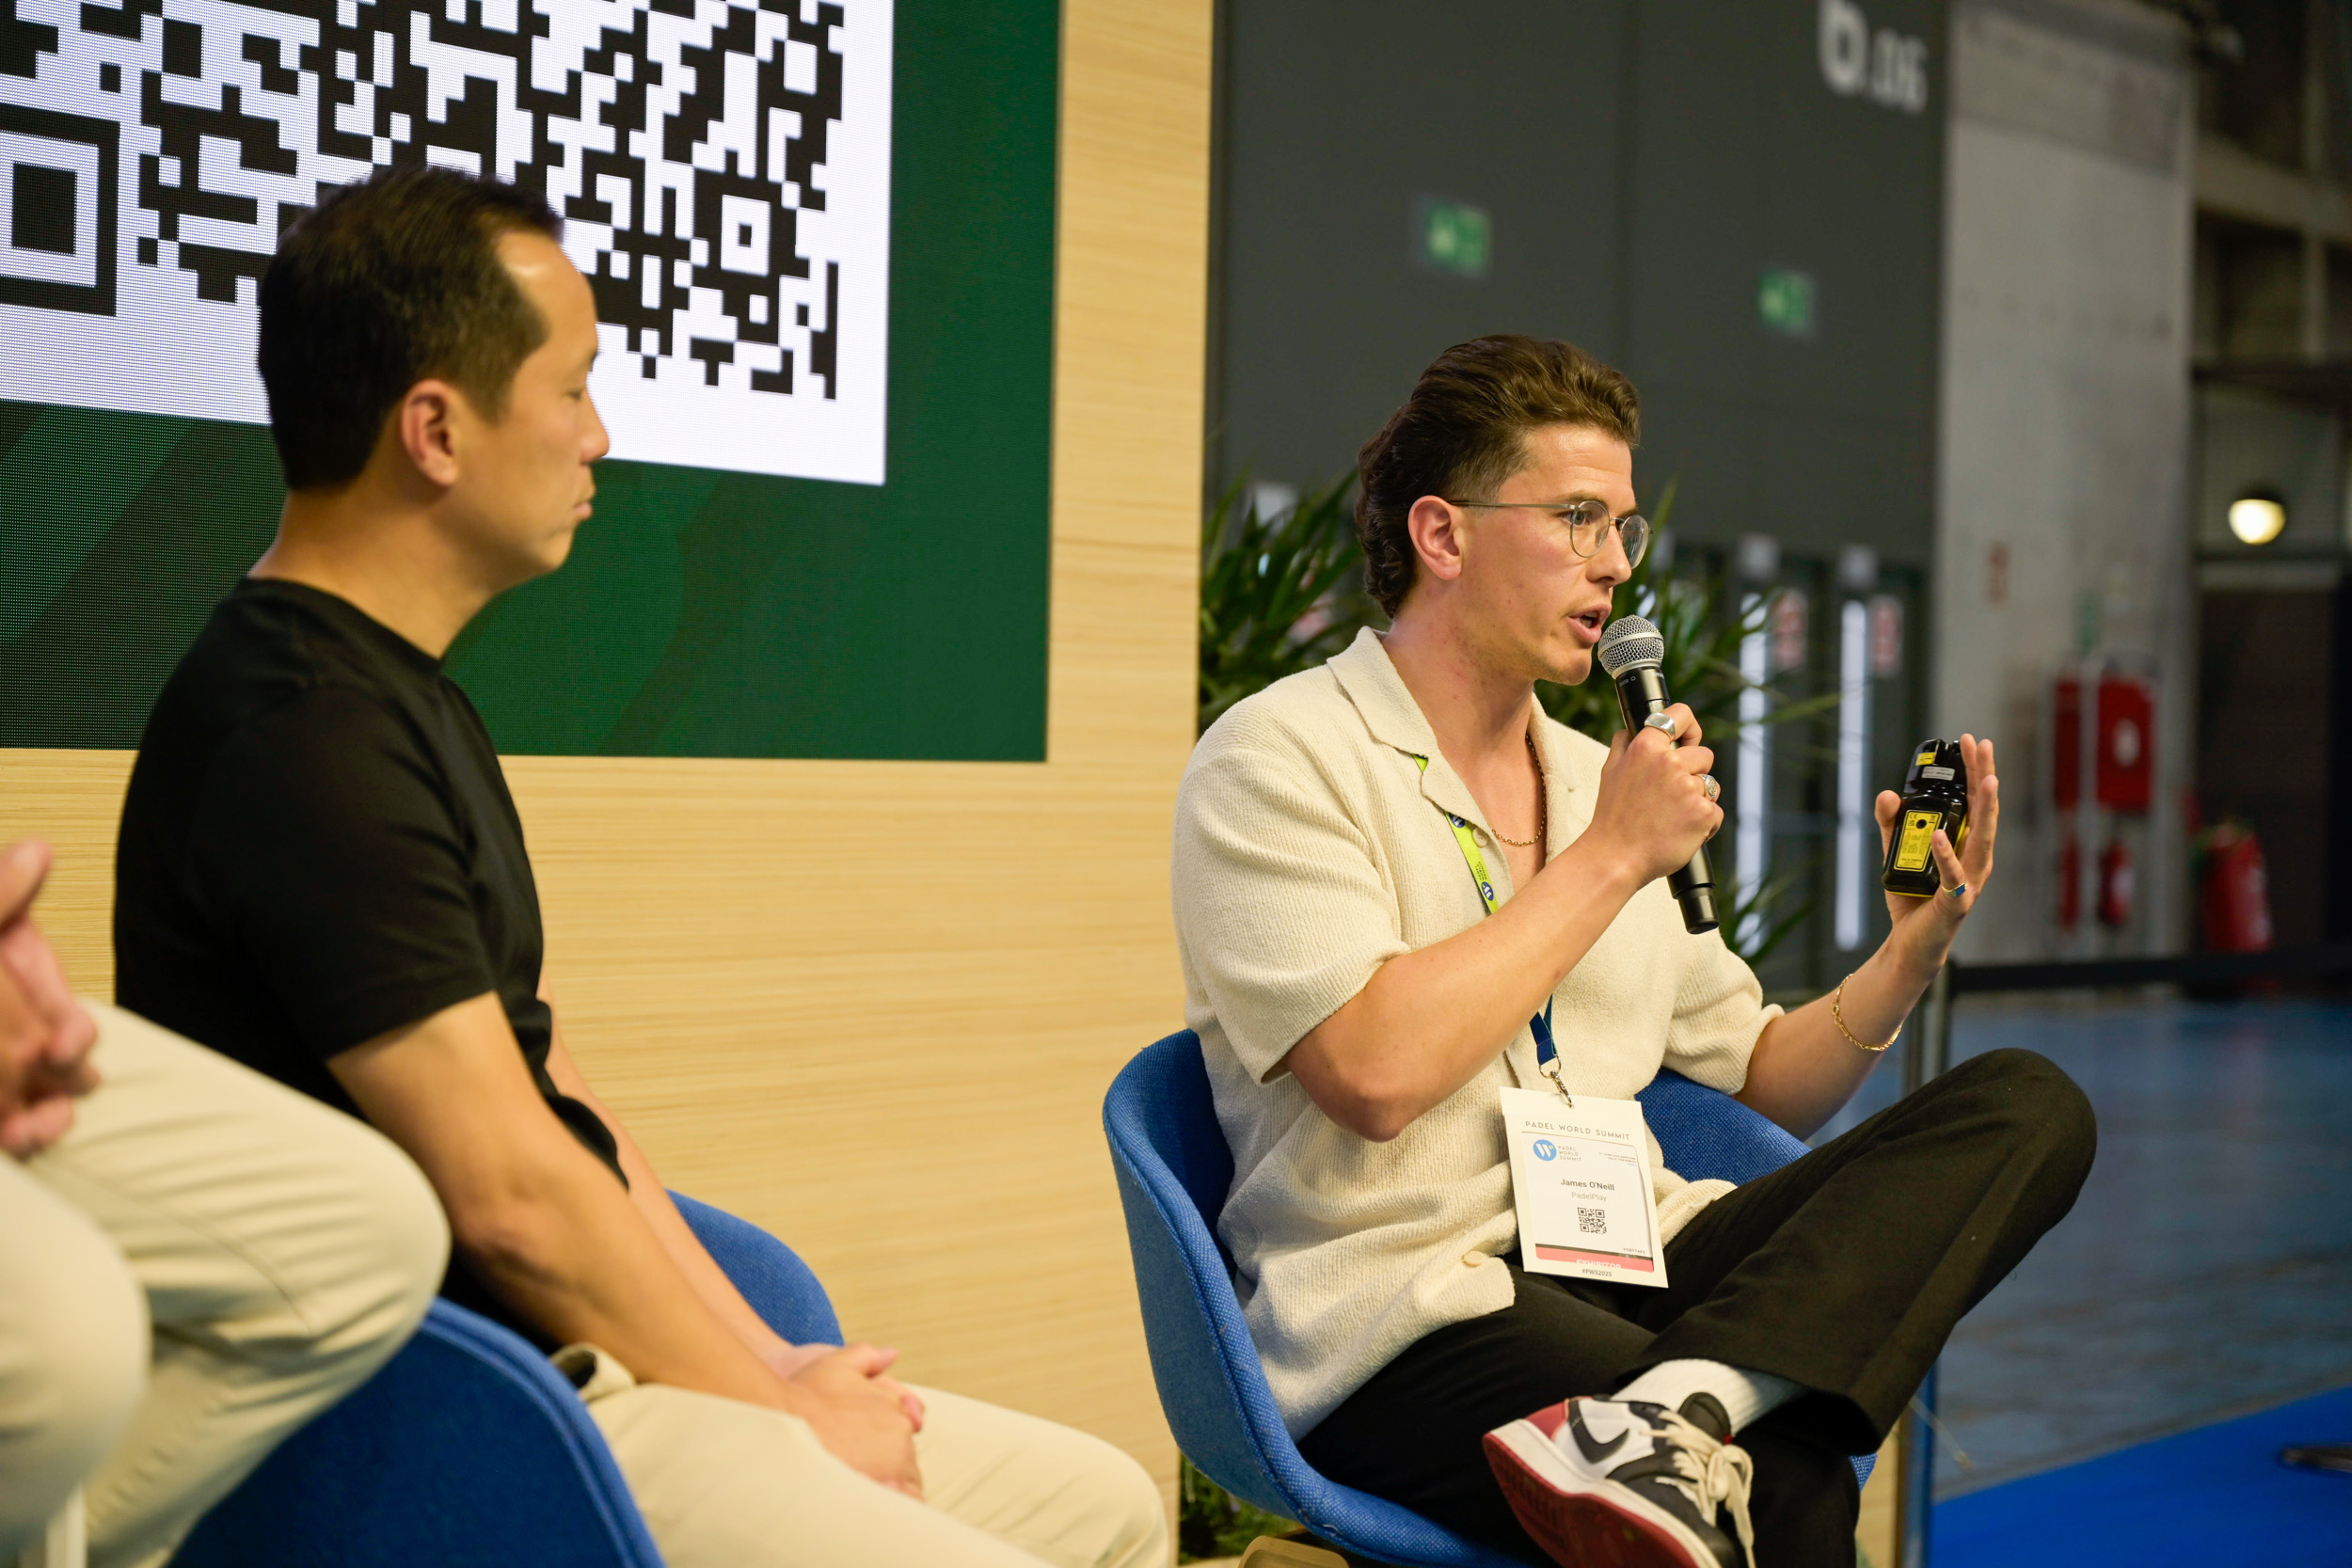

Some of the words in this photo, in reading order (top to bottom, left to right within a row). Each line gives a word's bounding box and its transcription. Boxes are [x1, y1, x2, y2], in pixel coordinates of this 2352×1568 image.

[1525, 1120, 1555, 1131] PADEL
[1558, 1124, 1591, 1134] WORLD
[1596, 1129, 1629, 1140] SUMMIT
[1561, 1179, 1587, 1187] James
[1589, 1181, 1615, 1191] O'Neill
[1571, 1191, 1607, 1202] PadelPlay
[1581, 1268, 1613, 1277] #PWS2025
